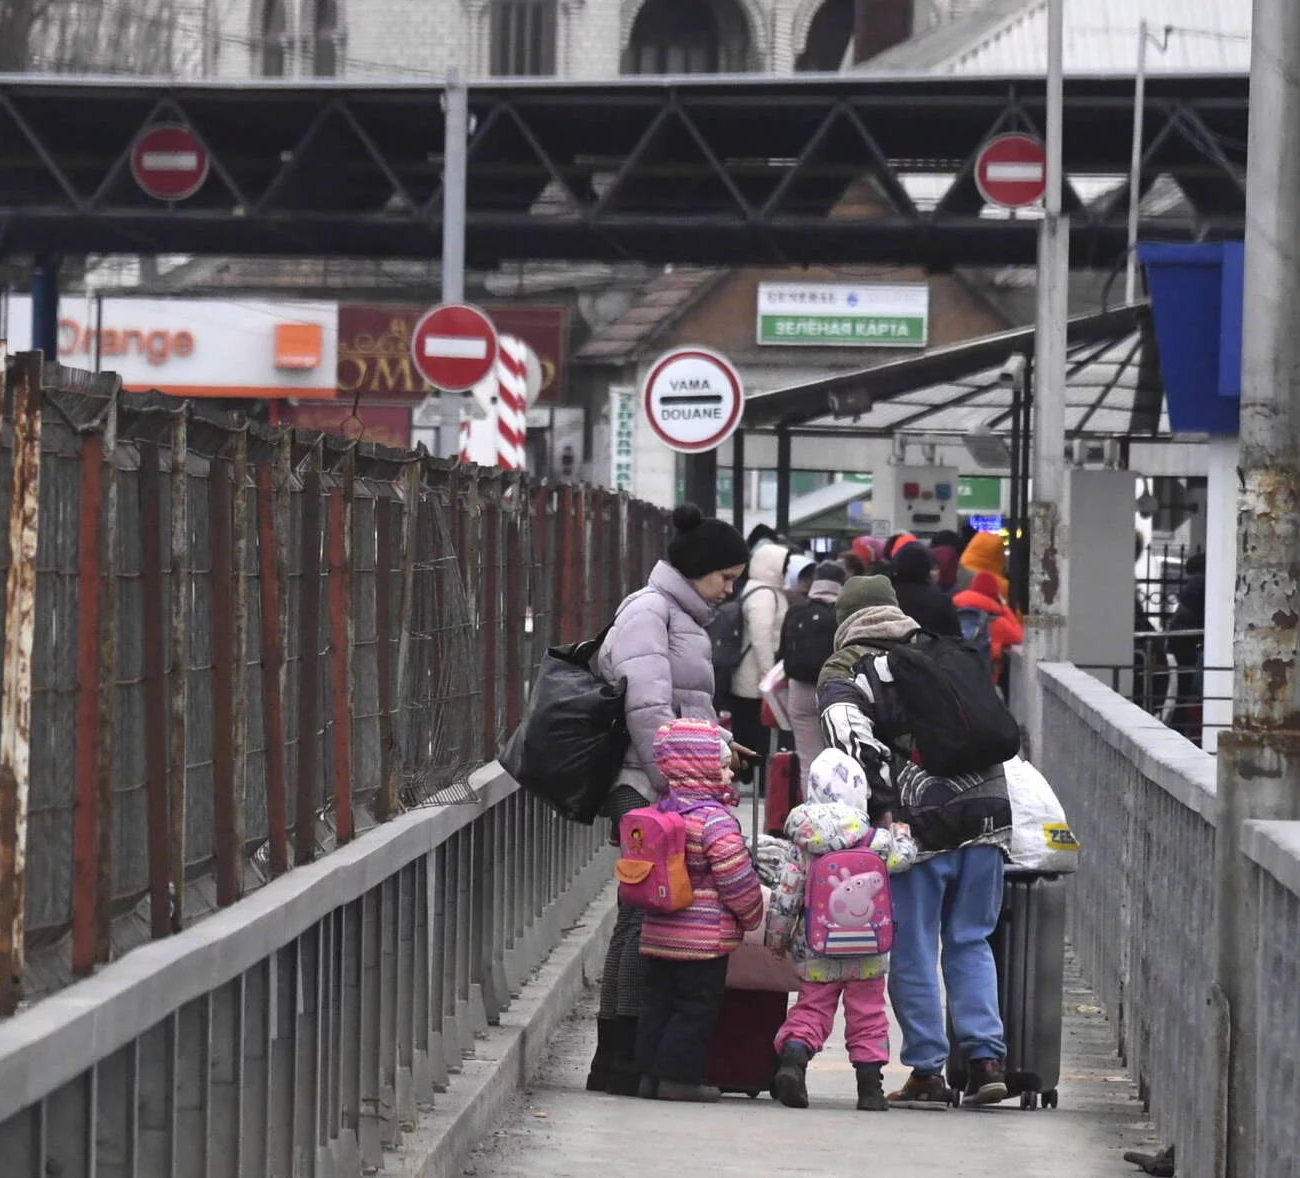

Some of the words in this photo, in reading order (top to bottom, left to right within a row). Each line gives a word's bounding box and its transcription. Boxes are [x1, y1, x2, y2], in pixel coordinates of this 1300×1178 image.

[855, 320, 909, 337] КАРТА
[58, 318, 195, 366] Orange
[669, 380, 711, 391] VAMA
[661, 408, 722, 420] DOUANE
